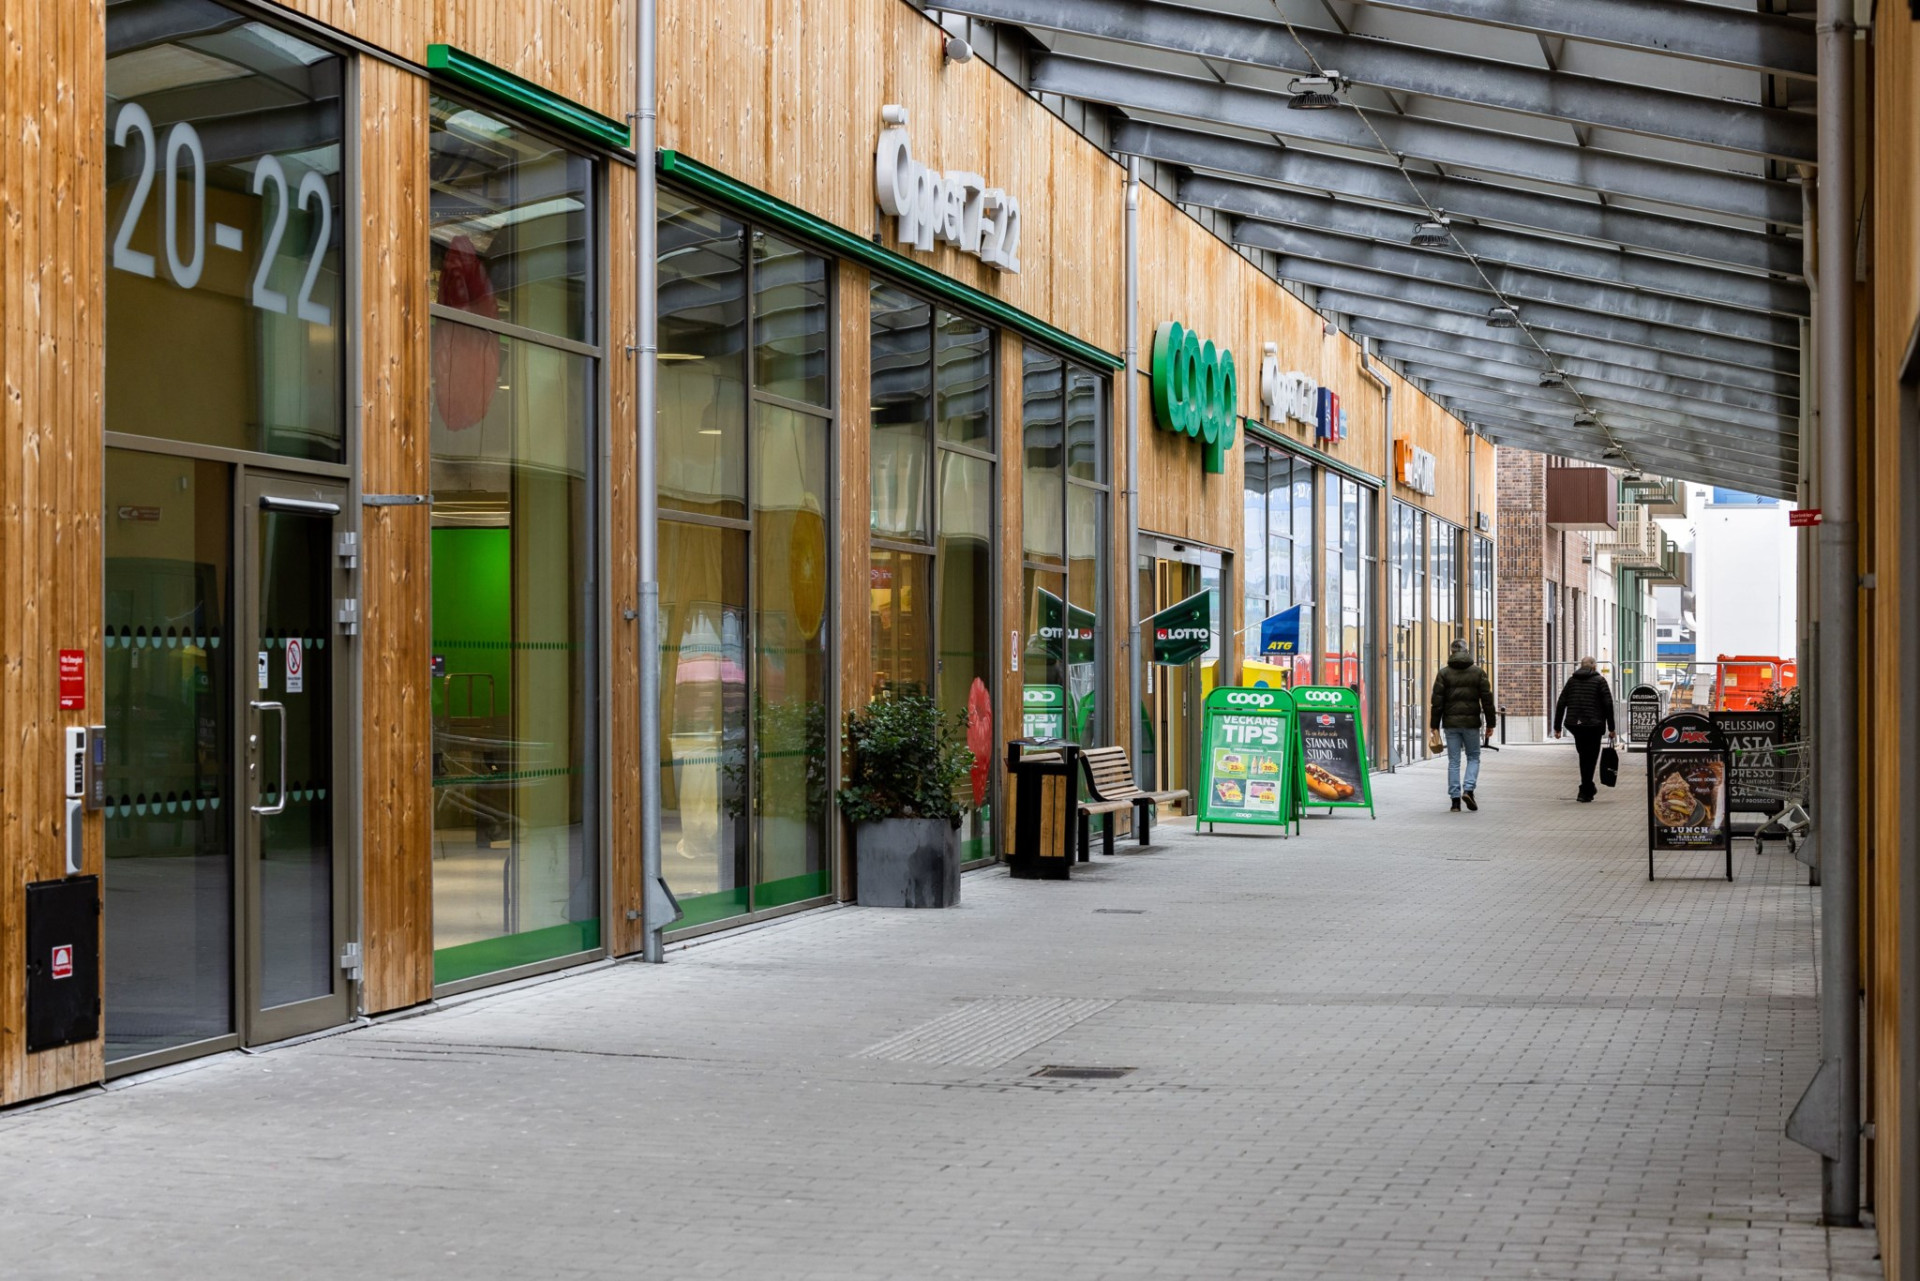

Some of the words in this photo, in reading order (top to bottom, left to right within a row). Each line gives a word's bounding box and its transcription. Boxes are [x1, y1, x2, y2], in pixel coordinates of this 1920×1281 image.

[1153, 320, 1237, 474] coop
[1168, 628, 1209, 640] LOTTO
[1267, 641, 1293, 650] ATG
[1226, 692, 1274, 708] coop
[1305, 690, 1342, 704] coop
[1223, 715, 1279, 727] VECKANS
[1632, 711, 1657, 719] PASTA
[1716, 720, 1775, 731] DELISSIMO
[1222, 724, 1279, 745] TIPS
[1680, 731, 1711, 744] MAX
[1305, 738, 1336, 749] STANNA
[1337, 738, 1348, 749] EN
[1730, 768, 1775, 778] PRESSO
[1670, 826, 1709, 834] LUNCH
